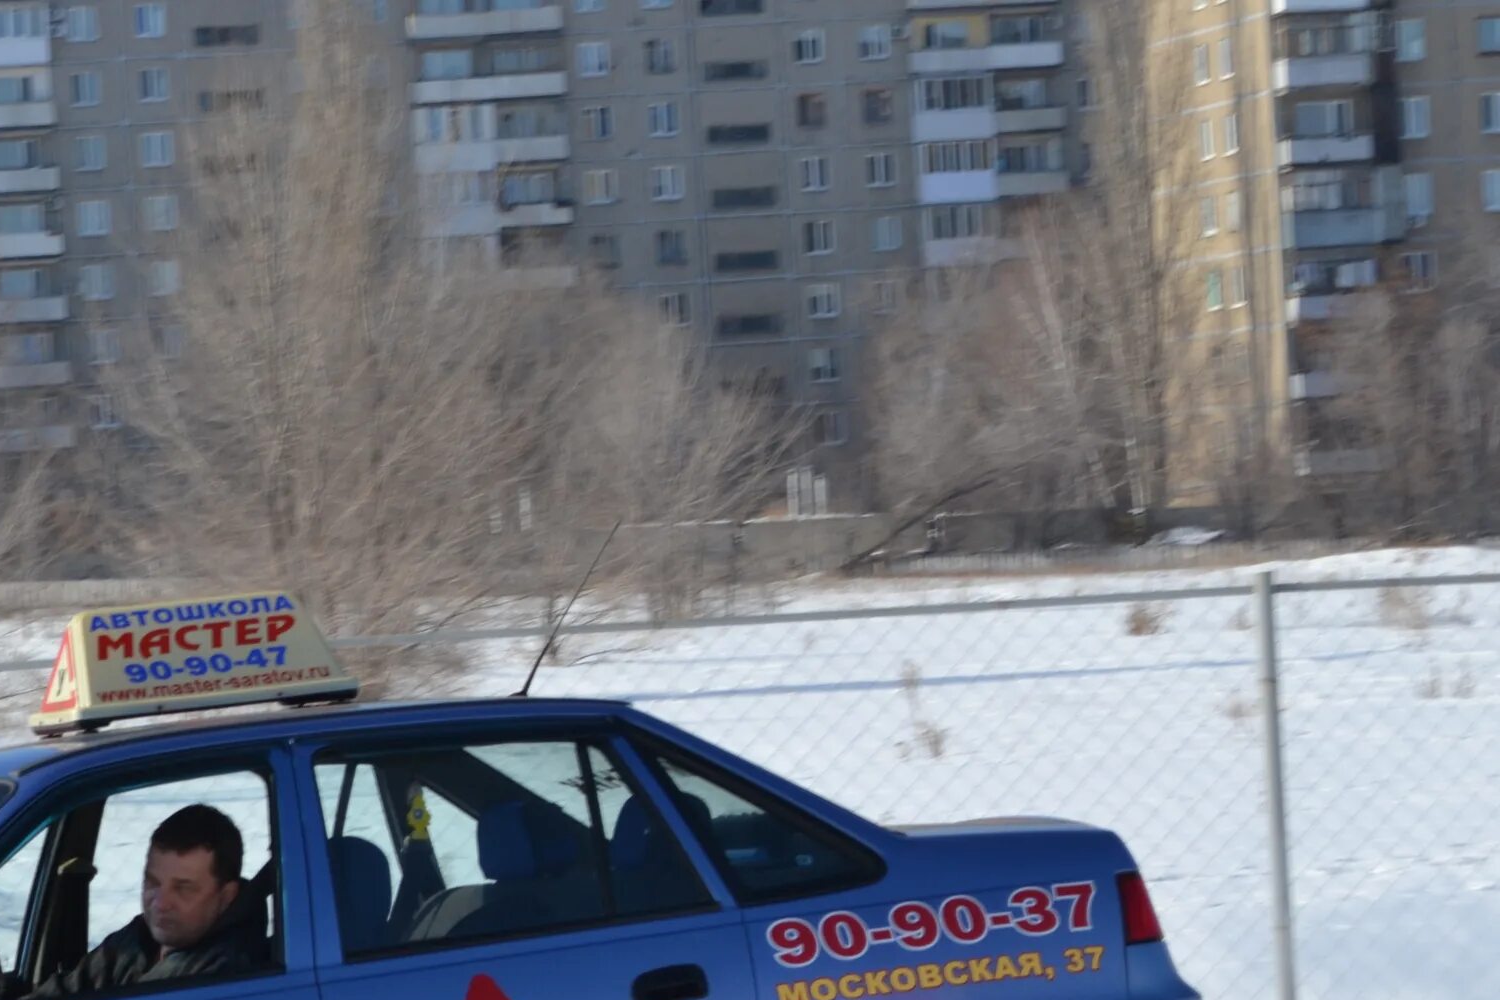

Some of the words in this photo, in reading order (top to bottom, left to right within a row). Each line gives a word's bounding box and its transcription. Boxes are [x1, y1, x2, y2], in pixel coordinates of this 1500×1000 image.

[89, 594, 296, 632] АВТОШКОЛА
[96, 614, 296, 661] МАСТЕР
[97, 664, 331, 703] www.master-saratov.ru
[124, 645, 288, 684] 90-90-47
[765, 880, 1097, 968] 90-90-37
[1063, 945, 1104, 973] 37
